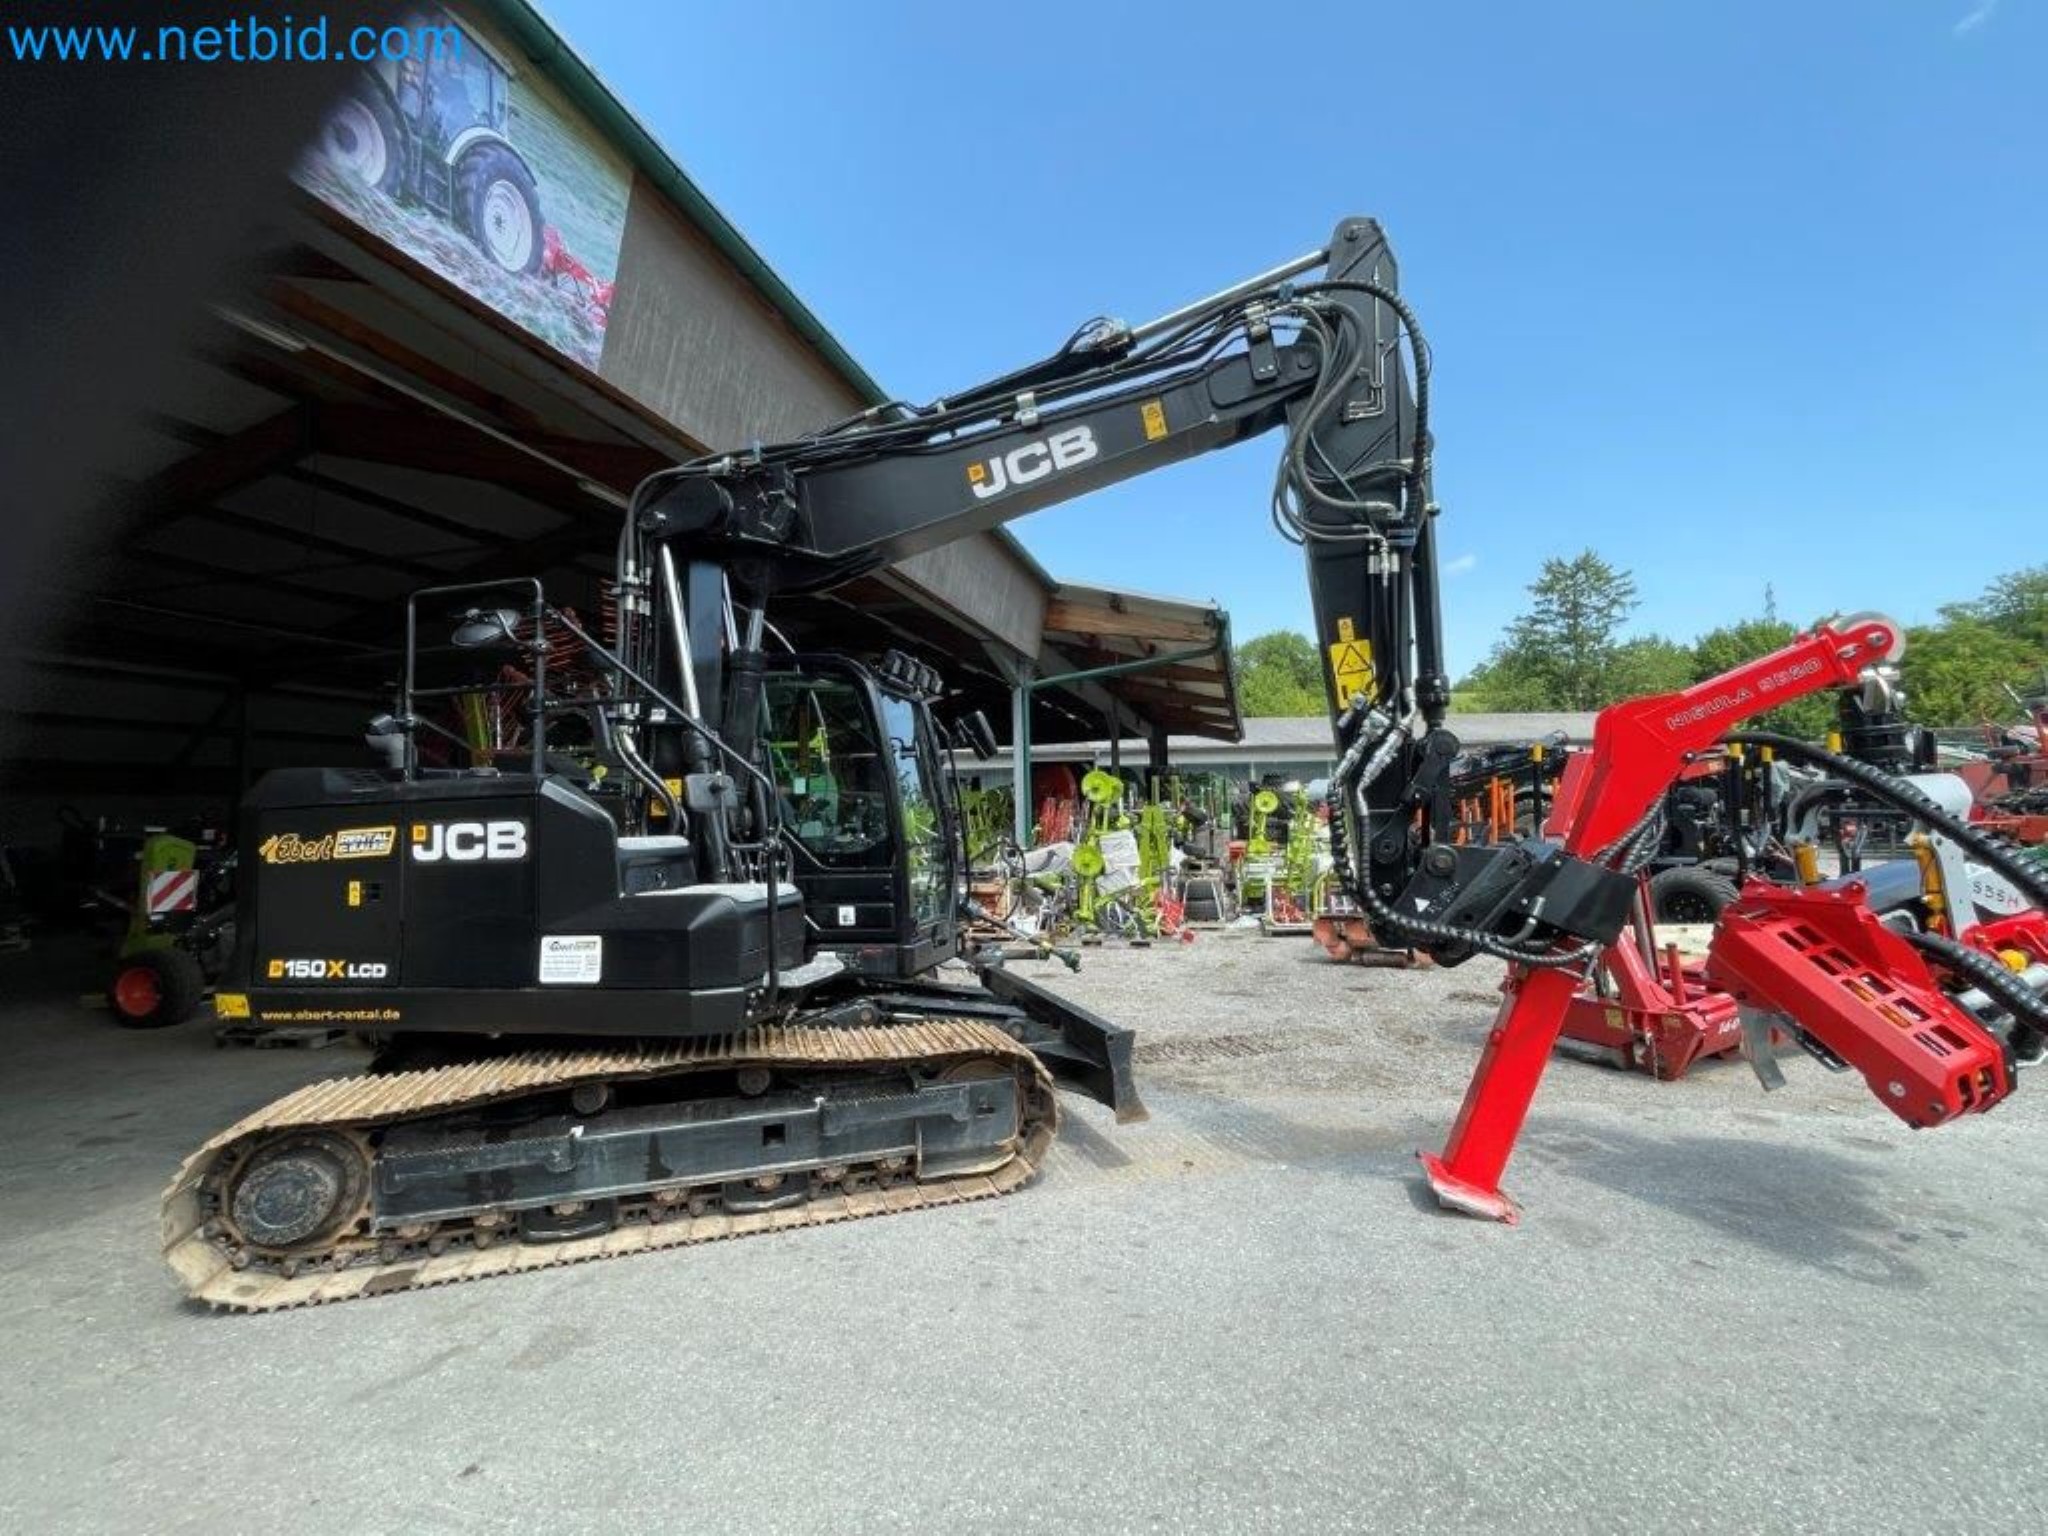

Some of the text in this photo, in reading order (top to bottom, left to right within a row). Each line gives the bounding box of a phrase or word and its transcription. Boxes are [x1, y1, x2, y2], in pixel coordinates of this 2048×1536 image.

[970, 425, 1098, 499] JCB
[412, 821, 527, 861] JCB
[260, 1008, 400, 1021] www.ebert-rental.de
